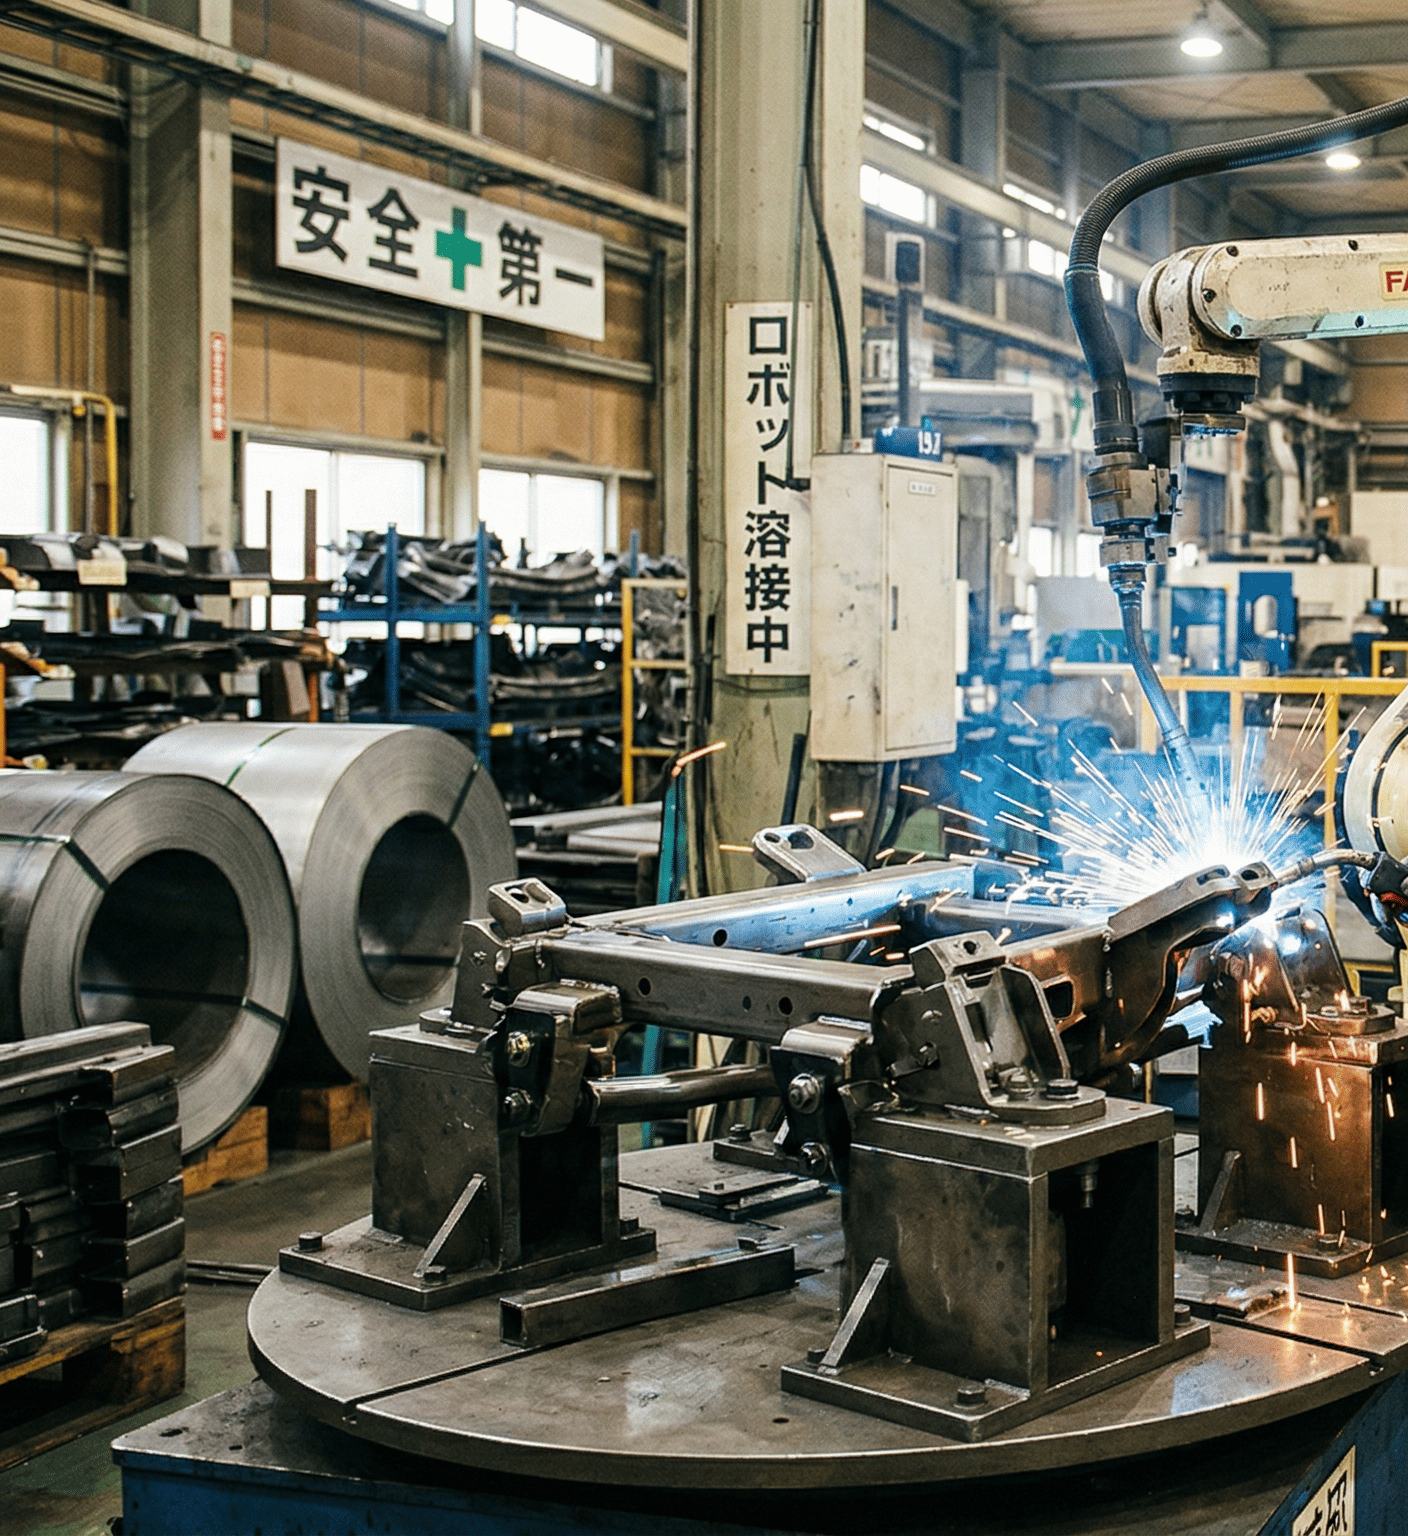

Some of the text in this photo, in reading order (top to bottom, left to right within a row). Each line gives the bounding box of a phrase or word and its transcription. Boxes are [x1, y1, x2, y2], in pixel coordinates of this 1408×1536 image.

[744, 316, 791, 664] ロボット溶接中
